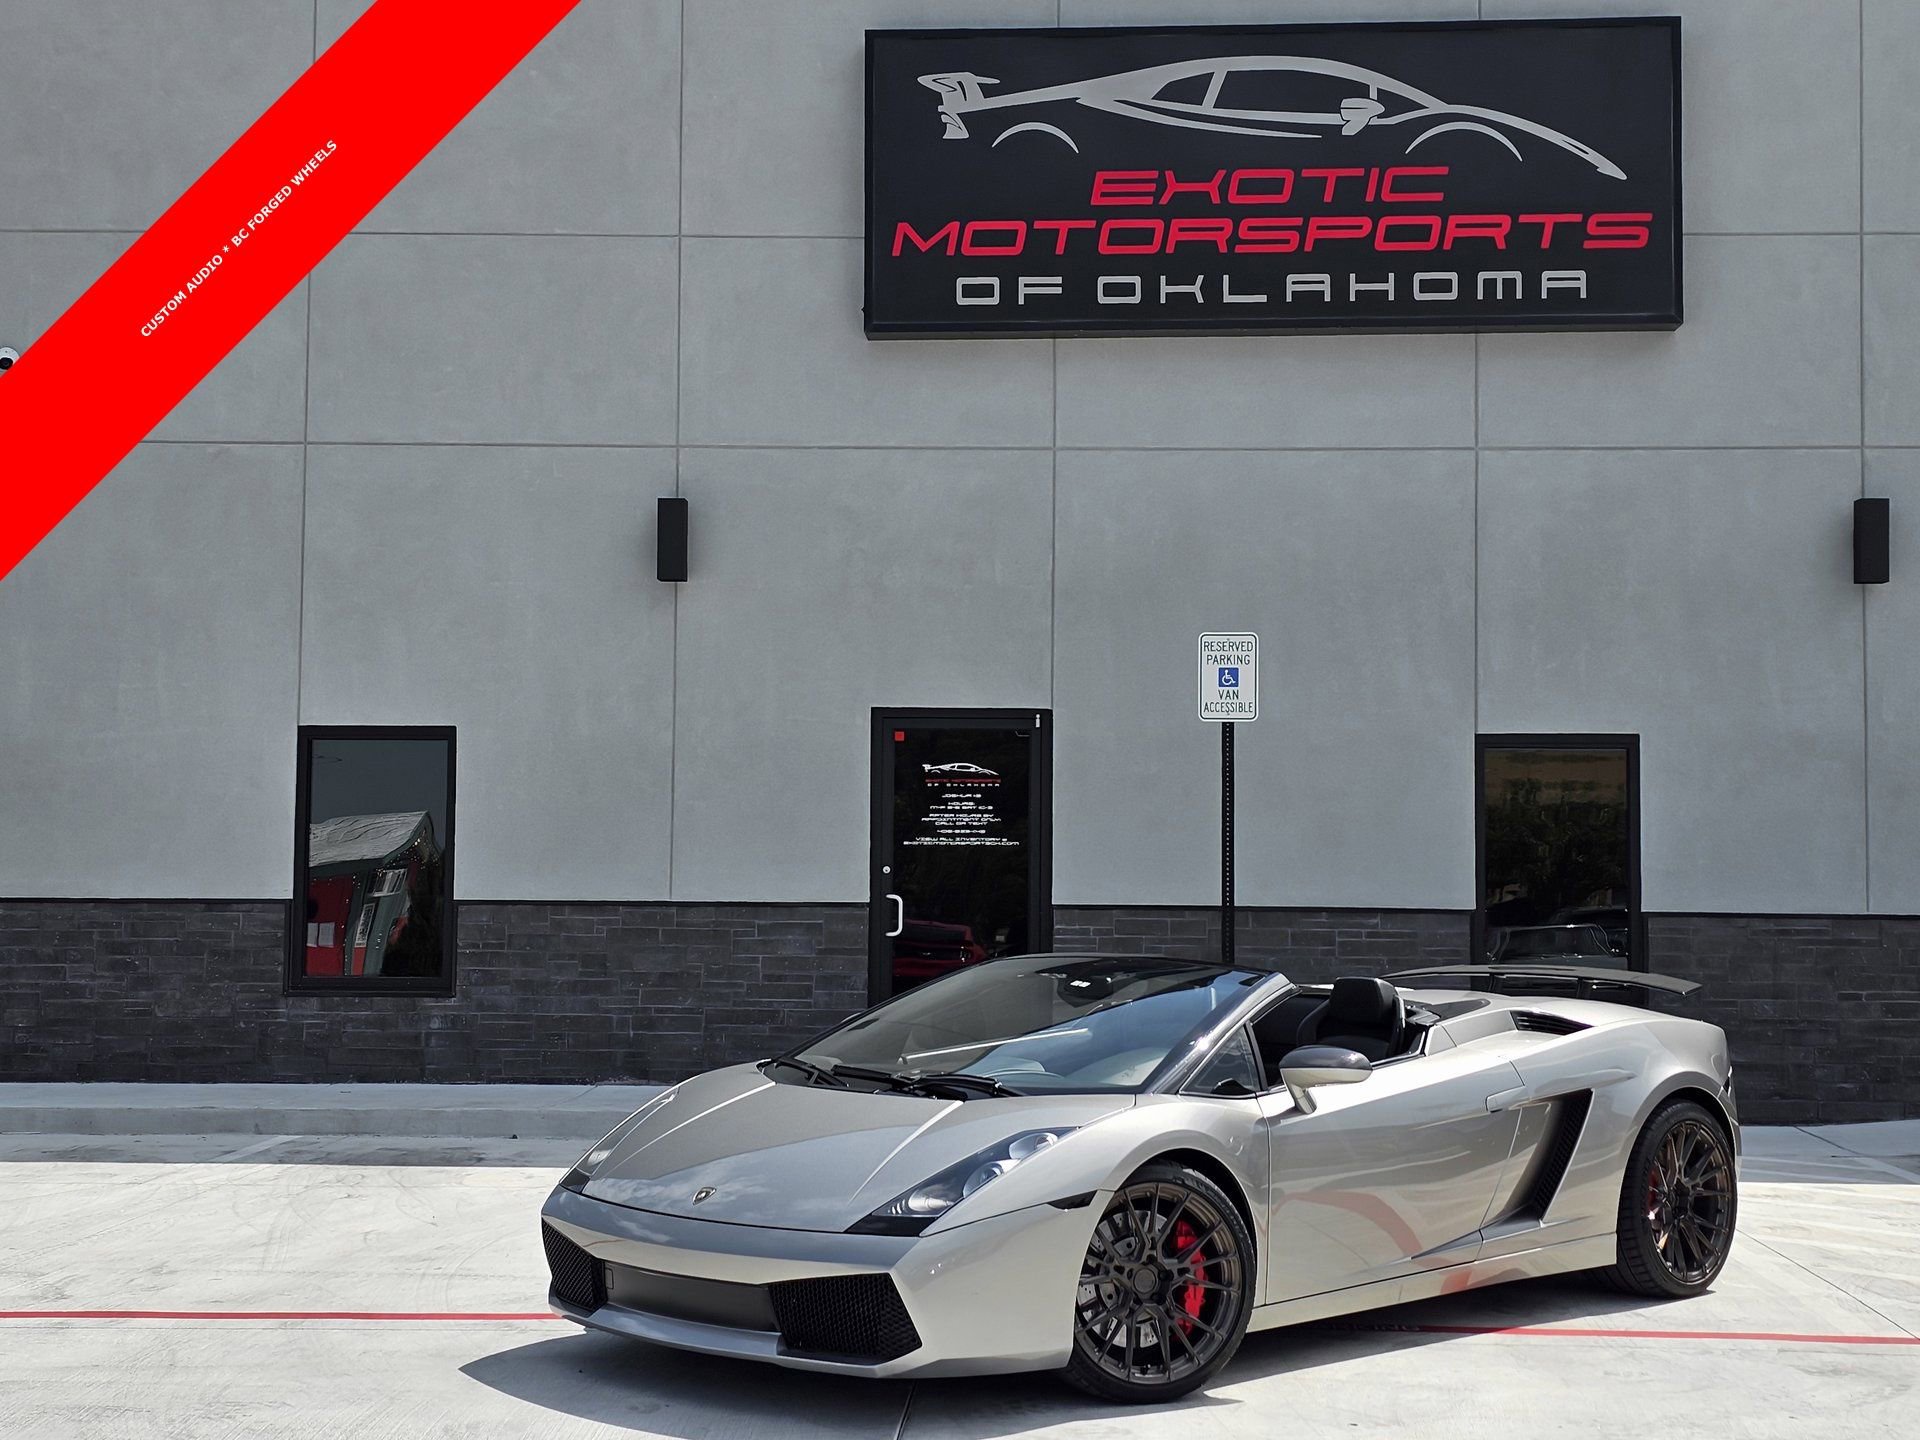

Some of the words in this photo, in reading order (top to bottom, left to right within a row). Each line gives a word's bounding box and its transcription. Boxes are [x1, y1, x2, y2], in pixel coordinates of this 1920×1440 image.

[1090, 166, 1449, 206] EXOTIC
[892, 212, 1653, 257] MOTORSPORTS
[956, 276, 1063, 306] OF
[1097, 269, 1588, 305] OKLAHOMA
[1203, 641, 1254, 652] RESERVED
[1206, 654, 1251, 666] PARKING
[1217, 689, 1239, 700] VAN
[1203, 701, 1254, 713] ACCESSIBLE
